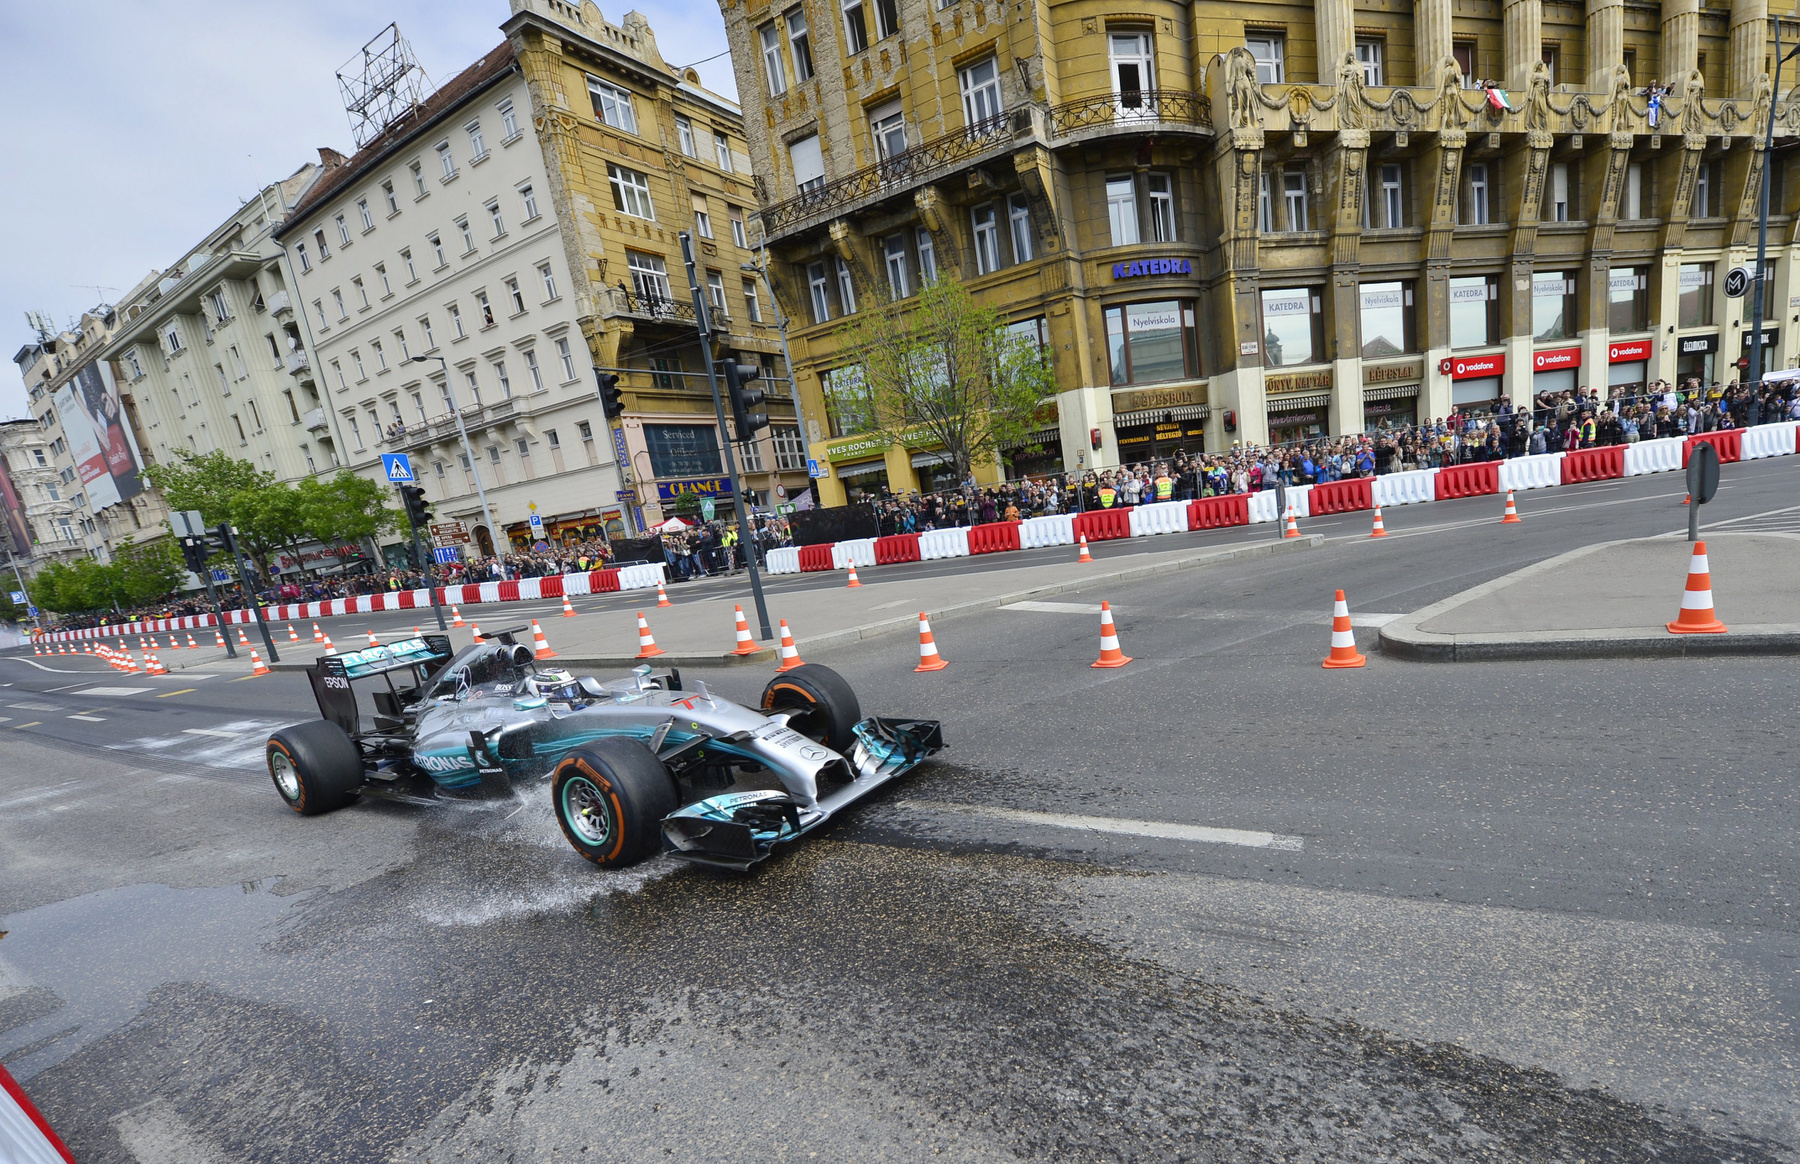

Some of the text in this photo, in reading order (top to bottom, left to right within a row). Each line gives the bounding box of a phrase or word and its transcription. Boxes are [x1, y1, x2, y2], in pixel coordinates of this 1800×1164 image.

[1112, 258, 1192, 279] KATEDRA
[1533, 284, 1563, 294] Nyelviskola
[1609, 279, 1635, 288] KATEDRA
[1453, 289, 1483, 299] KATEDRA
[1364, 295, 1399, 306] Nyelviskola
[1268, 301, 1305, 312] KATEDRA
[1132, 315, 1175, 328] Nyelviskola
[1618, 346, 1643, 356] vodafone
[1545, 354, 1571, 364] vodafone
[1466, 362, 1494, 371] vodafone
[1369, 366, 1414, 381] KÉPESLAP
[1295, 373, 1329, 389] NAPTÁR
[1132, 391, 1194, 408] KÉPESBOLT
[663, 430, 695, 440] Serviced
[902, 431, 924, 442] YVES
[826, 445, 847, 456] YVES
[670, 481, 722, 496] CHANGE
[339, 639, 426, 665] ETRONAS
[324, 676, 349, 689] EPSON
[729, 792, 768, 804] PETRONAS
